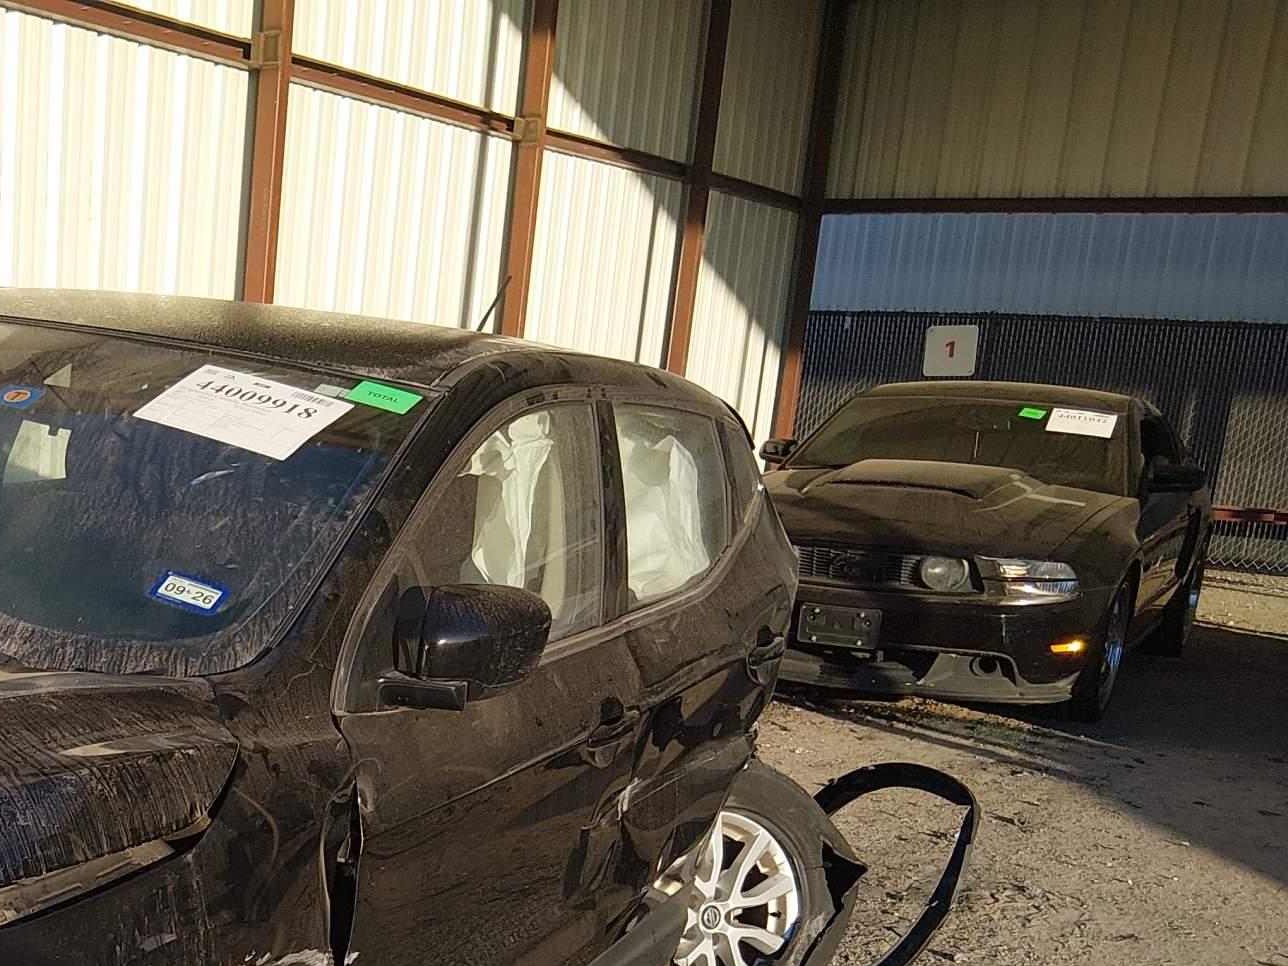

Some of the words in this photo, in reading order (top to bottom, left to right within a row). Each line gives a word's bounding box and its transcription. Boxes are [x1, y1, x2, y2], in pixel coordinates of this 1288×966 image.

[945, 341, 955, 358] 1
[196, 379, 317, 419] 44009918
[367, 390, 400, 404] TOTAL
